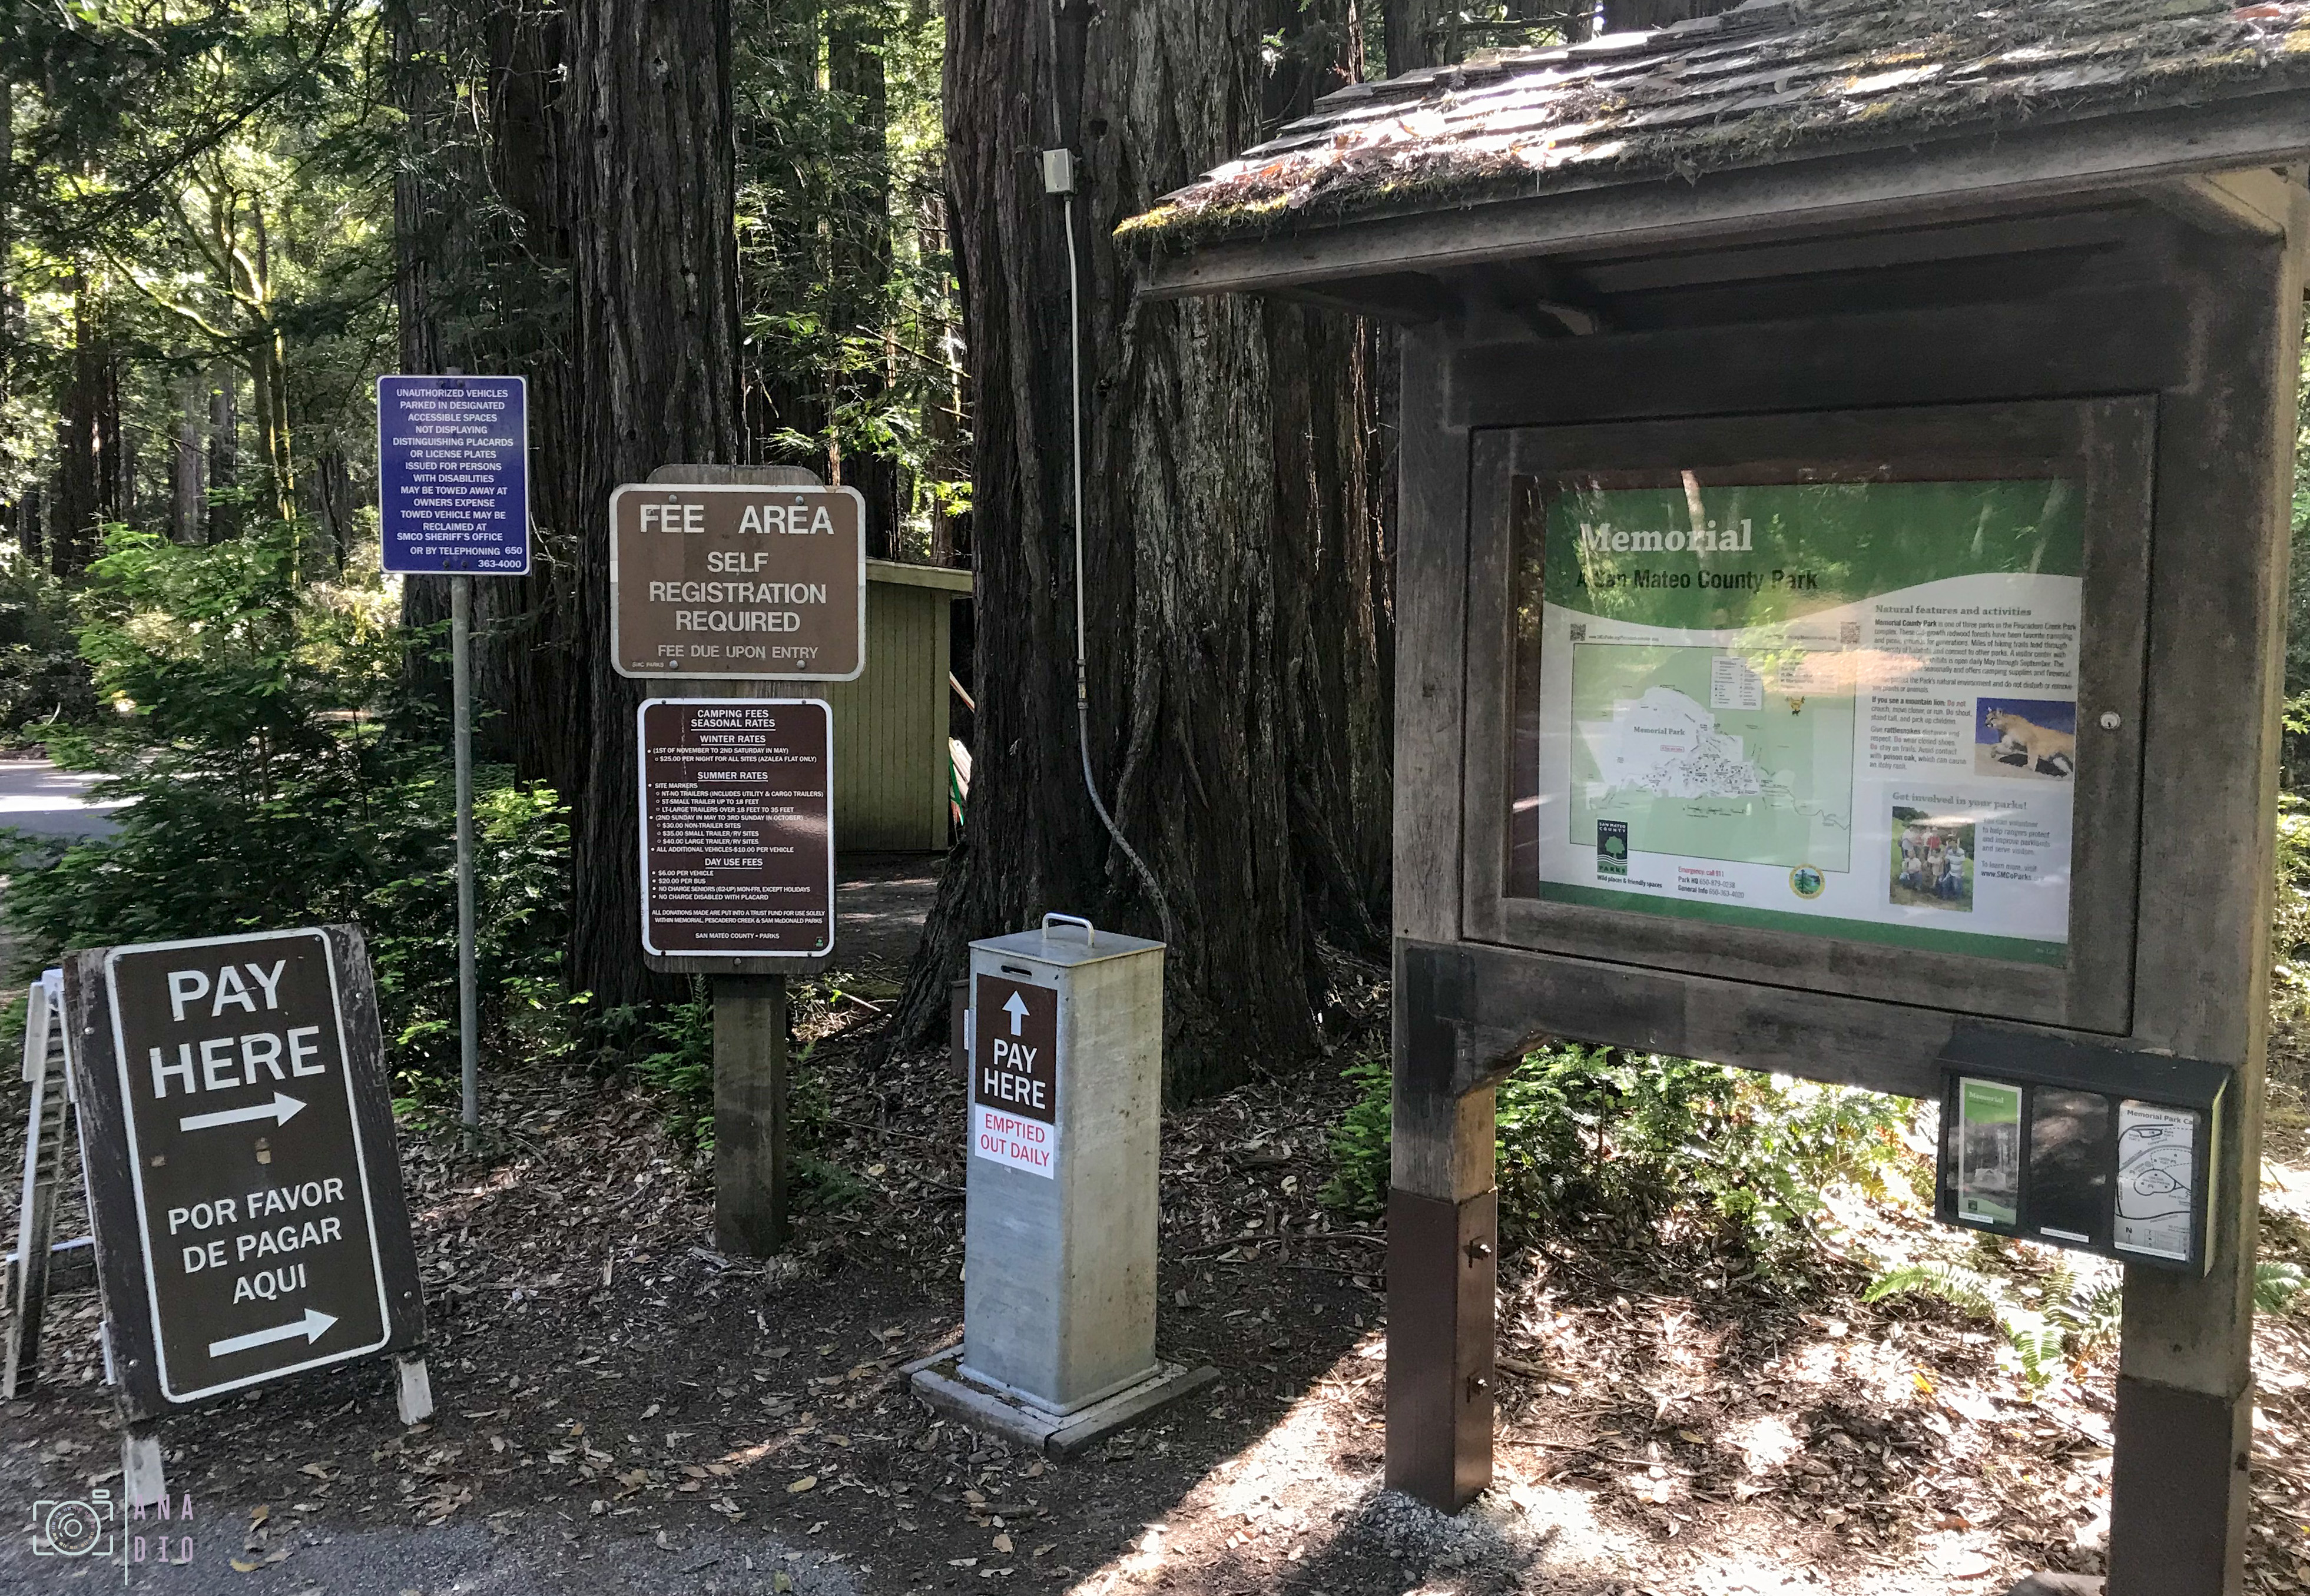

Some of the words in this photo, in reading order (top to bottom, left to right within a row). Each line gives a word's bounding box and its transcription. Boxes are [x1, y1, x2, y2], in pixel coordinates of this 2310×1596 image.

[396, 389, 463, 397] UNAUTHORIZED
[640, 504, 704, 532] FEE
[739, 505, 833, 534] AREA
[1579, 519, 1752, 552] Memorial
[478, 559, 521, 568] 363-4000
[707, 552, 768, 572] SELF
[649, 581, 826, 603] REGISTRATION
[1576, 570, 1586, 588] A
[1594, 570, 1627, 588] San
[1634, 570, 1691, 589] Mateo
[1698, 570, 1764, 594] County
[1772, 570, 1818, 589] Park
[676, 610, 800, 632] REQUIRED
[1875, 605, 1913, 613] Natural
[1915, 606, 1958, 615] features
[1960, 606, 1980, 615] and
[1982, 606, 2031, 616] activities
[658, 645, 684, 656] FEE
[691, 645, 719, 657] DUE
[726, 645, 765, 659] UPON
[772, 646, 818, 658] ENTRY
[1893, 792, 1908, 801] Get
[1912, 793, 1954, 804] involved
[1956, 797, 1966, 805] in
[1968, 798, 1991, 807] your
[1628, 878, 1646, 888] friendly
[1678, 885, 1697, 893] General
[167, 959, 287, 1022] PAY
[148, 1025, 326, 1099] HERE
[994, 1038, 1038, 1073] PAY
[985, 1067, 1046, 1109] HERE
[985, 1113, 1045, 1143] EMPTIED
[2127, 1110, 2162, 1120] Memorial
[2164, 1115, 2181, 1124] Park
[980, 1134, 1006, 1154] OUT
[1010, 1142, 1050, 1167] DAILY
[168, 1199, 237, 1235] POR
[247, 1177, 344, 1219] FAVOR
[183, 1245, 228, 1273] DE
[237, 1217, 343, 1262] PAGAR
[233, 1263, 307, 1305] AQUI
